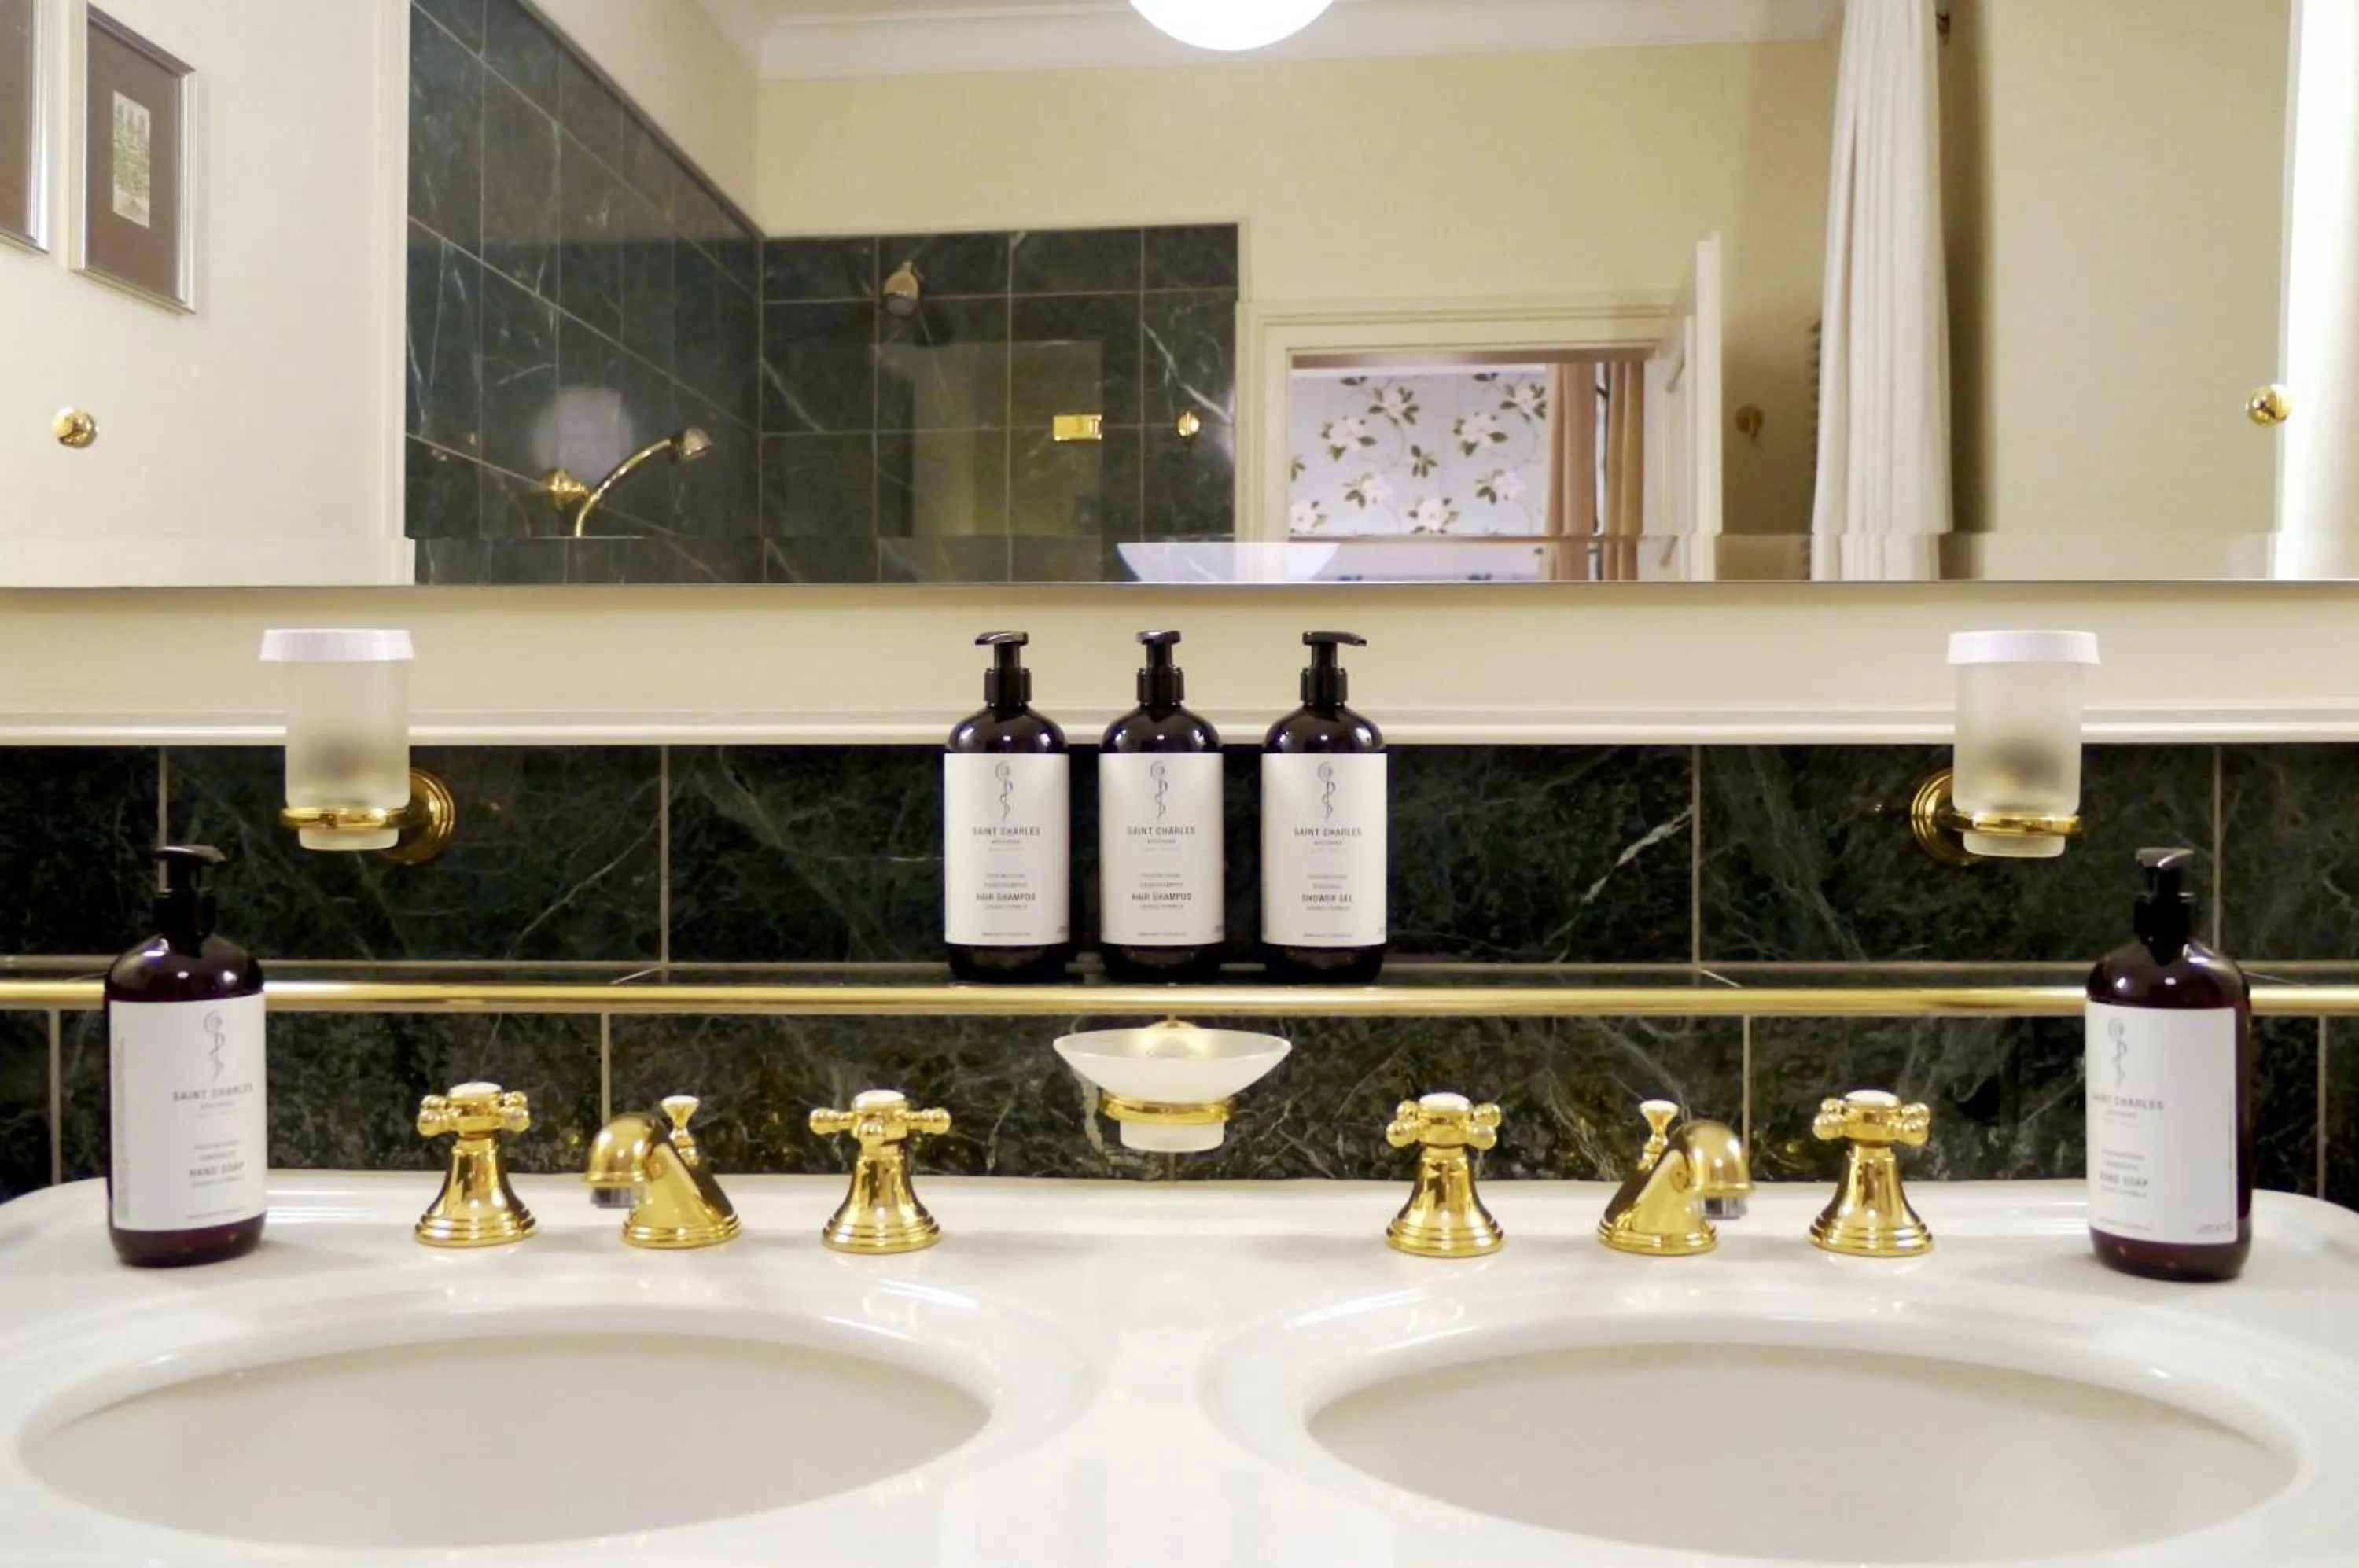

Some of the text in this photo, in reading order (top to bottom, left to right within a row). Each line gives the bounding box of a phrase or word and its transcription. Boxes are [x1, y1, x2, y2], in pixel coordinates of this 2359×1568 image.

[972, 827, 1040, 836] SAINT CHARLES
[1128, 826, 1196, 835] SAINT CHARLES
[1294, 828, 1362, 837] SAINT CHARLES
[173, 1083, 252, 1102] SAINT CHARLES
[2114, 1095, 2164, 1111] CHARLES
